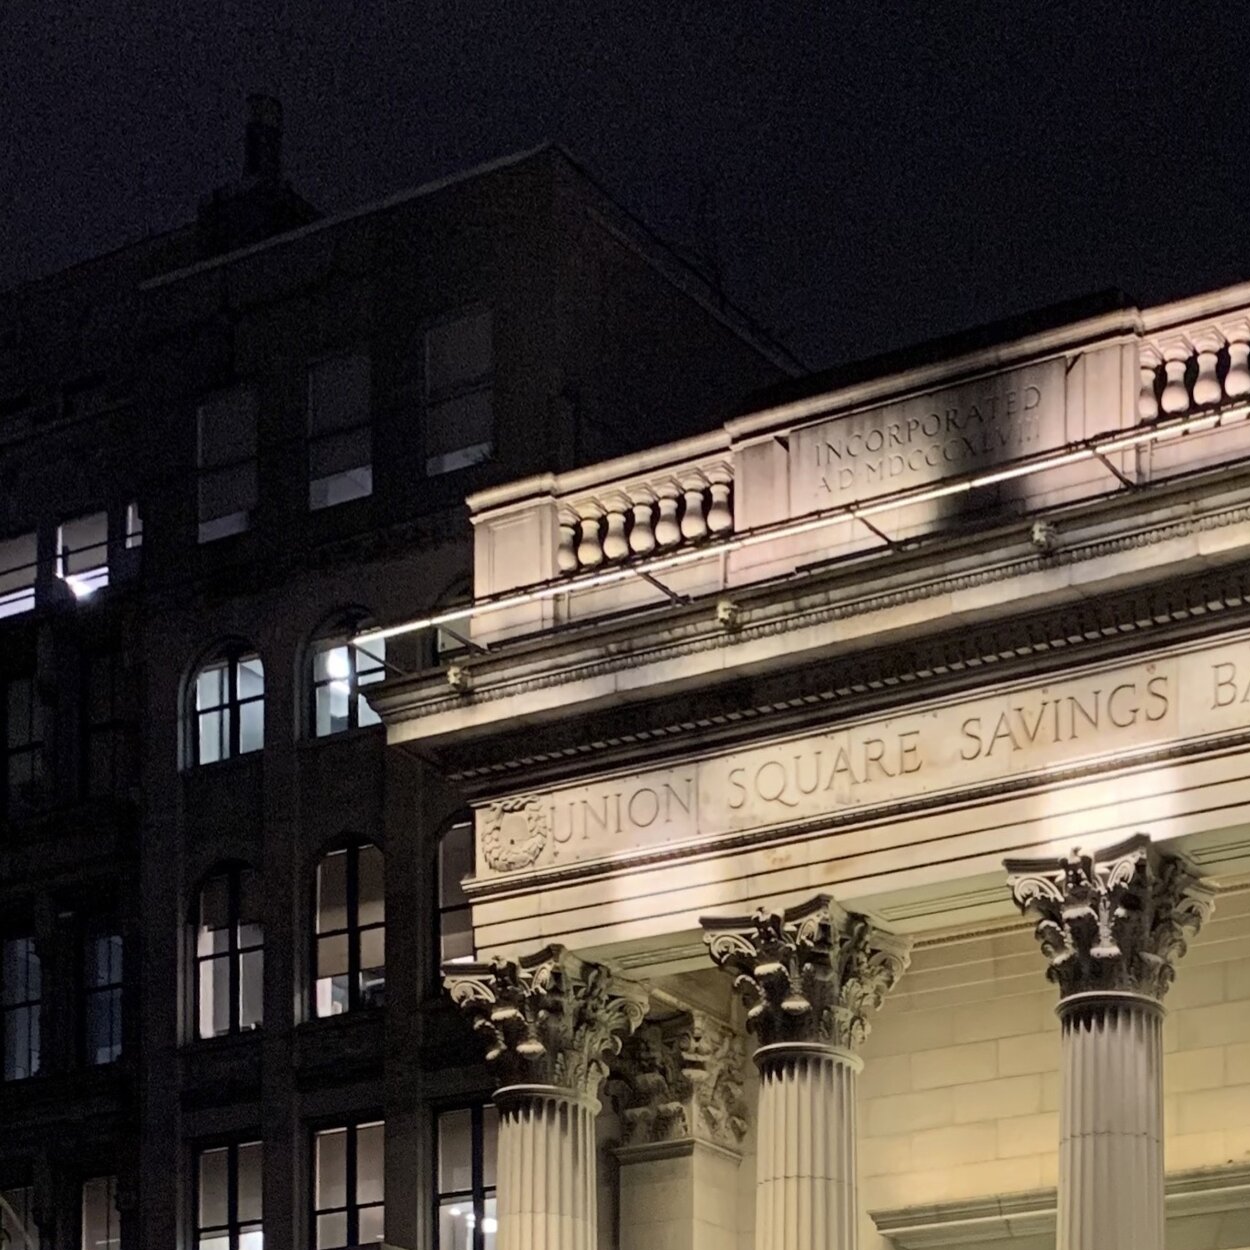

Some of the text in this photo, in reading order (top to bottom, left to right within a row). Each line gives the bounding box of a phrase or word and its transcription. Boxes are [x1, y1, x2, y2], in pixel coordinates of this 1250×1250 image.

[815, 385, 1041, 467] INCORPORATED
[550, 777, 692, 845] UNION
[727, 730, 922, 809] SQUARE
[960, 676, 1168, 760] SAVINGS
